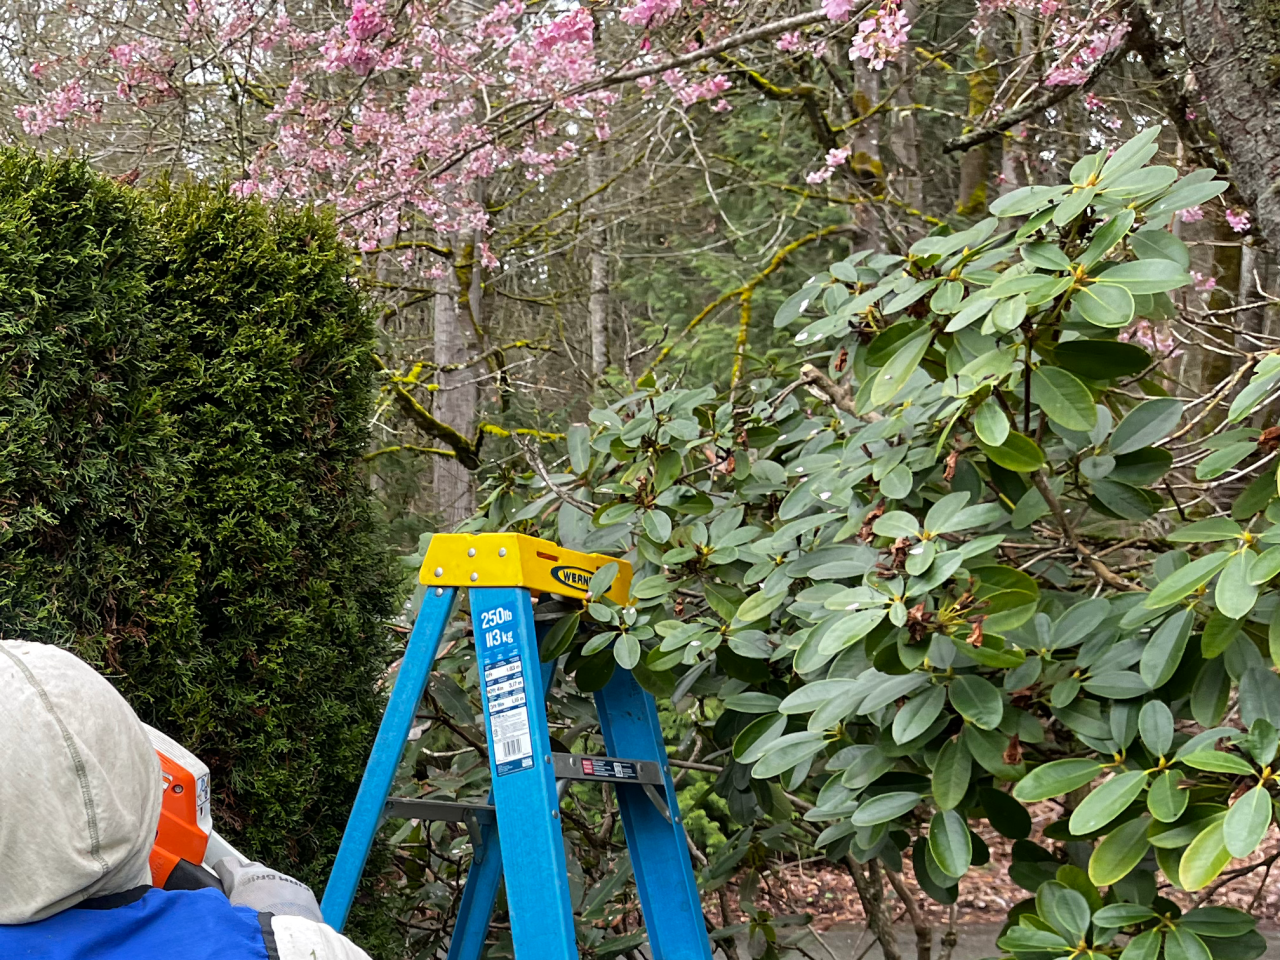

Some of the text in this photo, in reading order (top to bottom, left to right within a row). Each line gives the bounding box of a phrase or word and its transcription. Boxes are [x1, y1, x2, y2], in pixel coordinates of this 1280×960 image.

[562, 569, 592, 586] WERN
[485, 628, 514, 648] 113 kg
